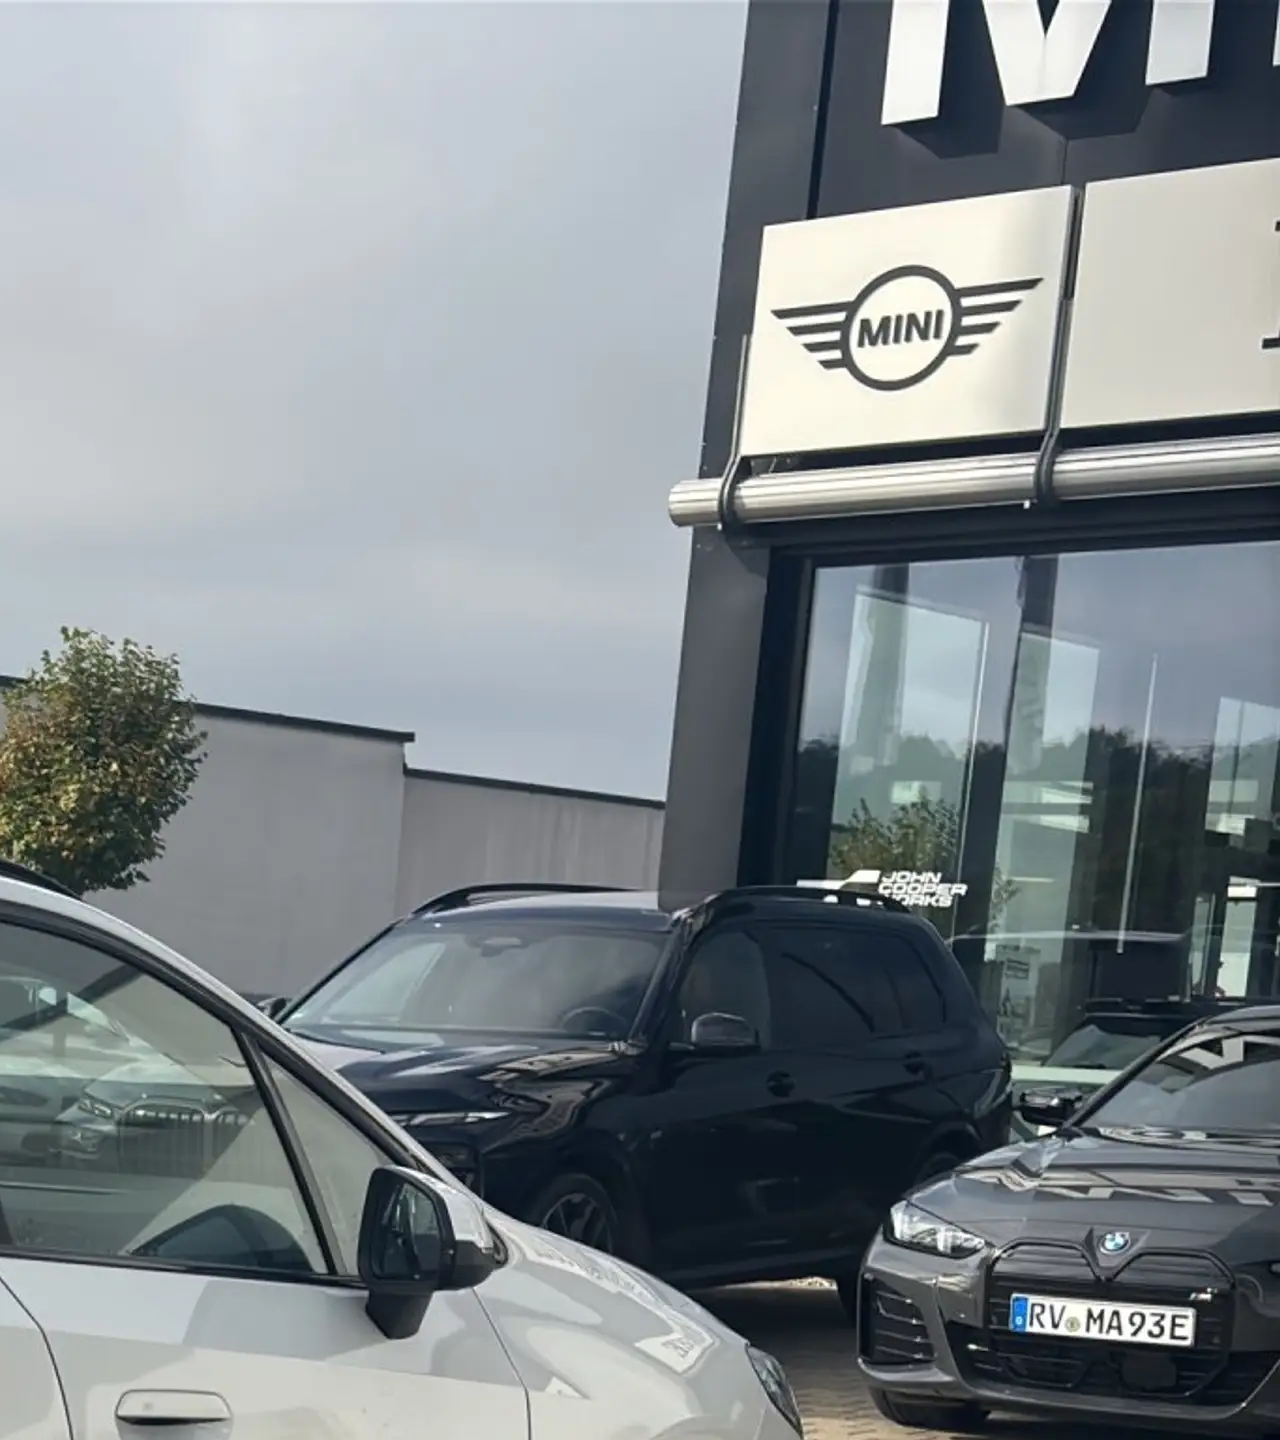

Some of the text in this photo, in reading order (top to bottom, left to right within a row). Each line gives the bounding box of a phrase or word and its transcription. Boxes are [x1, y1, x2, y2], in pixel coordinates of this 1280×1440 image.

[856, 308, 946, 350] MINI
[881, 870, 942, 883] JOHN
[877, 882, 969, 897] COOPER
[1028, 1302, 1067, 1330] RV
